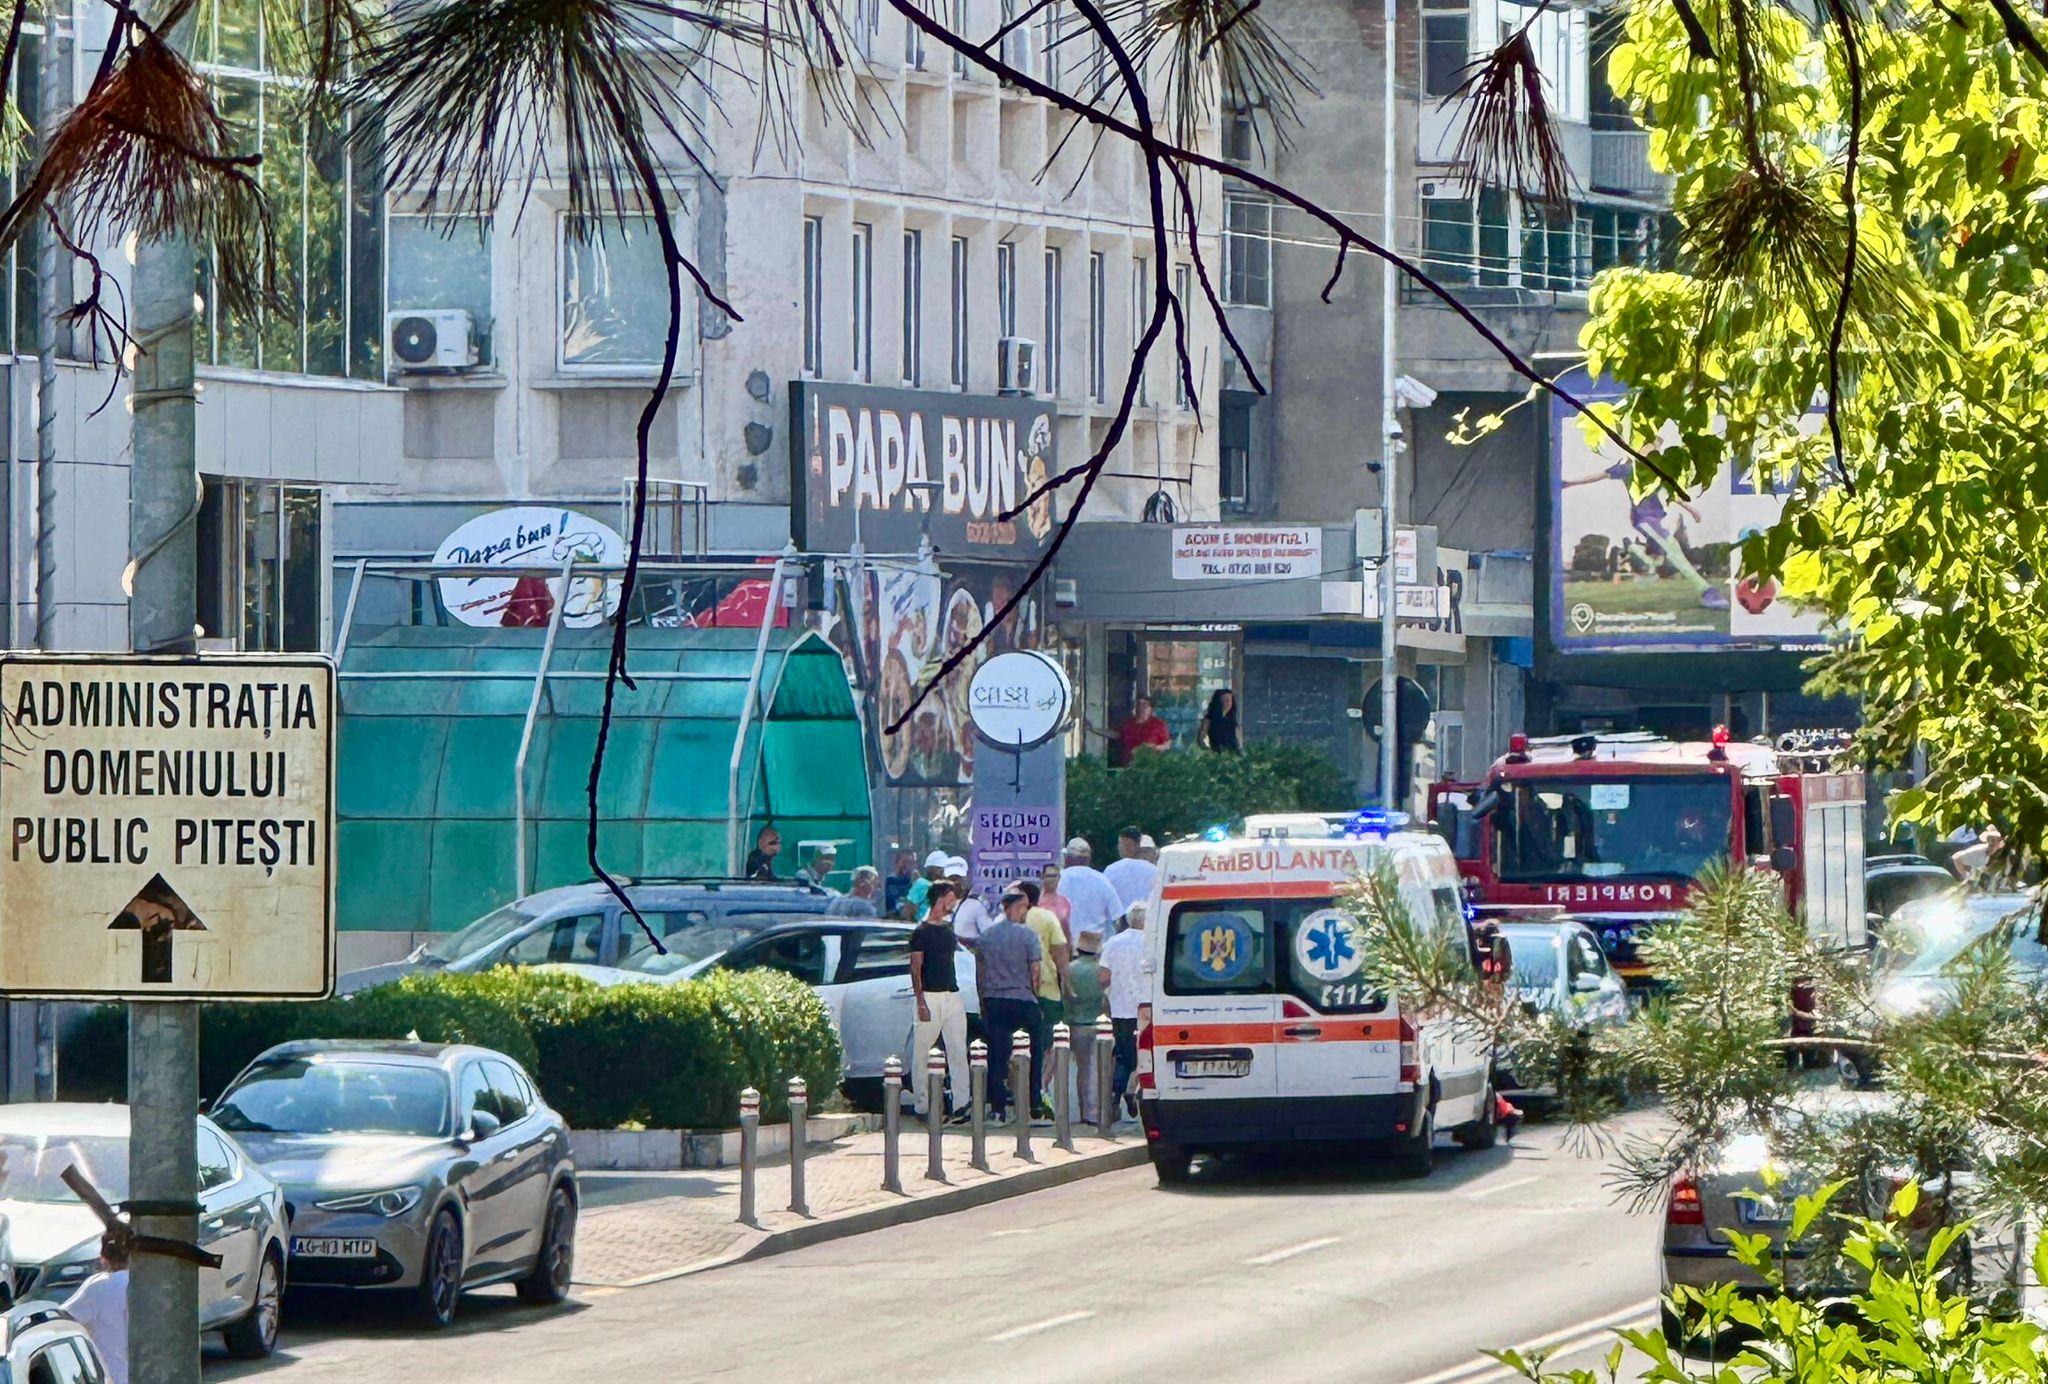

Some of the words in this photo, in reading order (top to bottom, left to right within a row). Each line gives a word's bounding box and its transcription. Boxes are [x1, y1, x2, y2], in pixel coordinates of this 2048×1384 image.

[828, 405, 931, 512] PAPA
[942, 415, 1016, 518] BUN
[15, 681, 316, 739] ADMINISTRAȚIA
[44, 749, 286, 797] DOMENIULUI
[12, 817, 149, 864] PUBLIC
[175, 819, 315, 877] PITEȘTI
